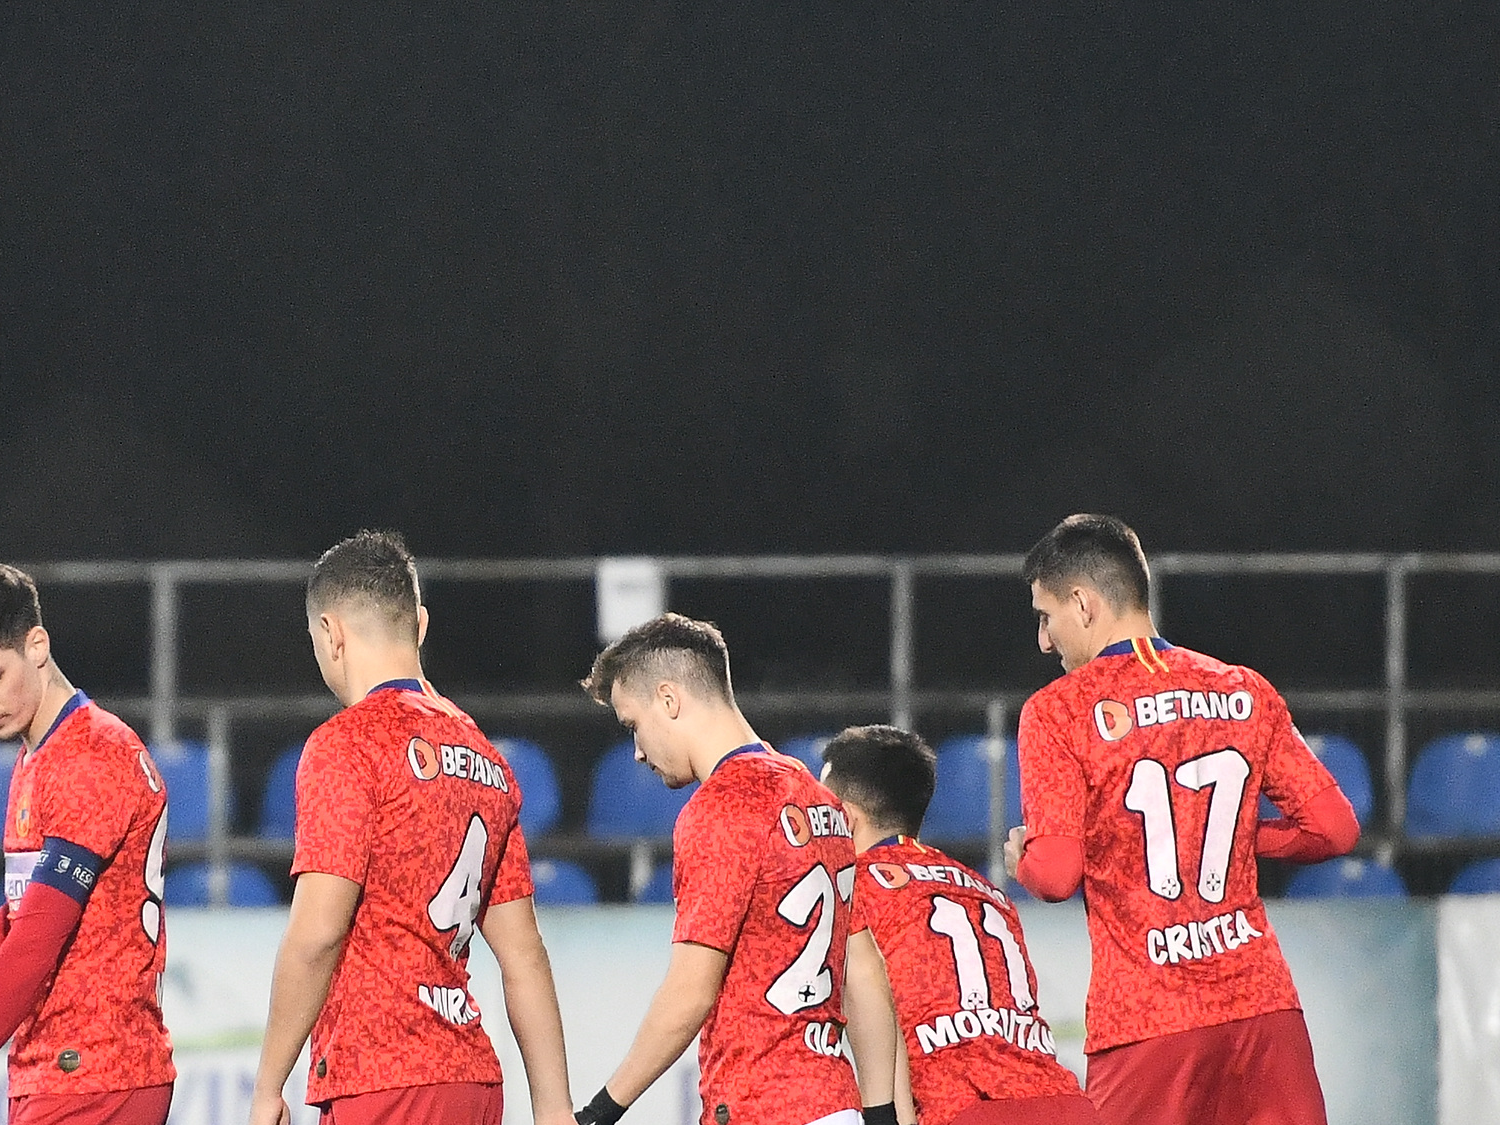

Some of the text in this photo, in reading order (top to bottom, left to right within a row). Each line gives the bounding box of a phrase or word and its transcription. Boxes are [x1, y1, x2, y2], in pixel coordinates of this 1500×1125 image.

[1135, 689, 1253, 728] BETANO
[440, 744, 508, 793] BETANO
[1125, 748, 1250, 903] 17
[905, 863, 1011, 910] BETANO
[929, 896, 1035, 1012] 11
[1147, 909, 1263, 966] CRISTEA
